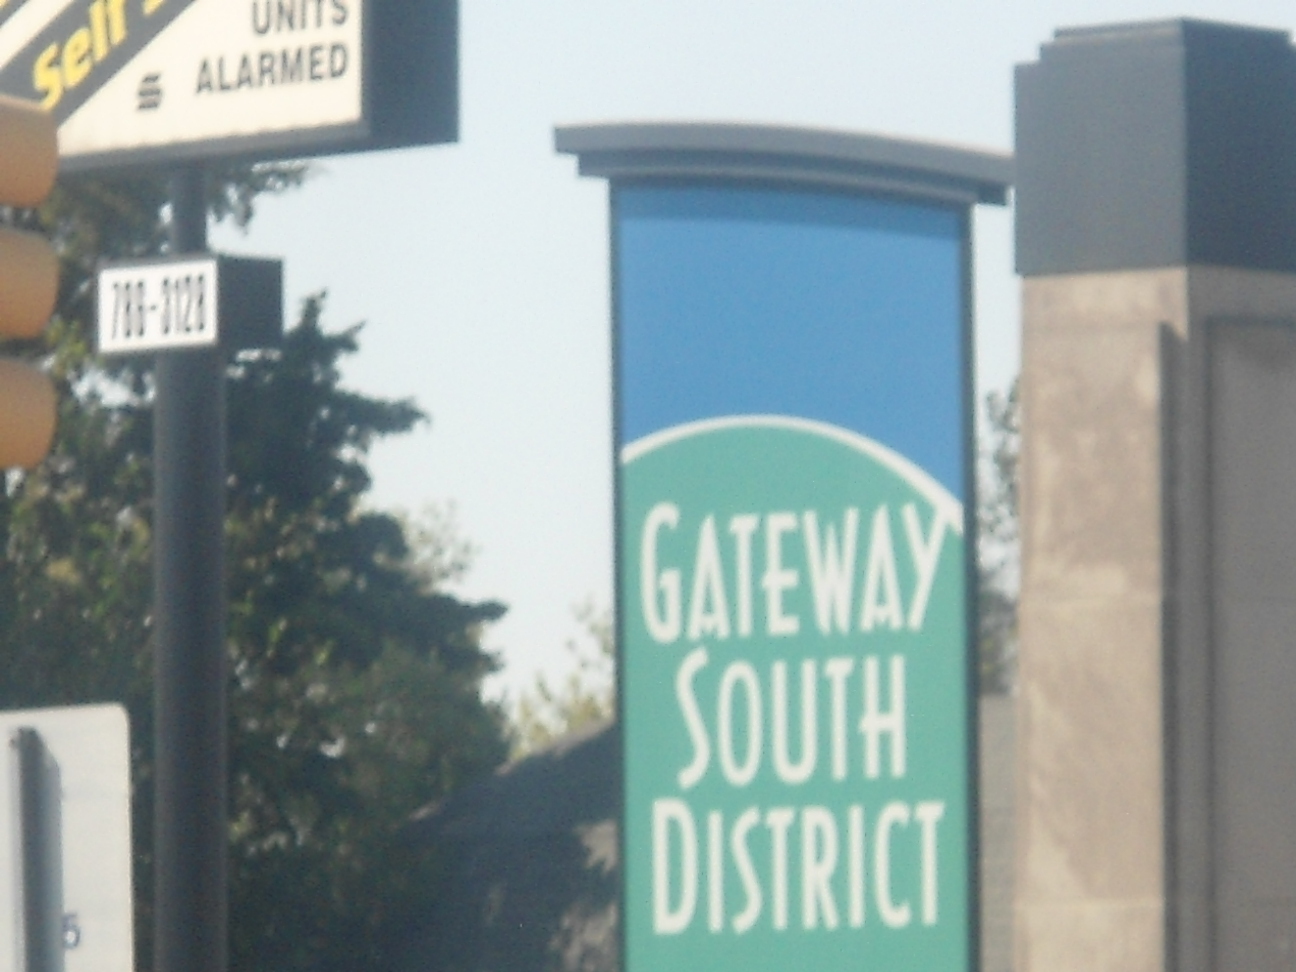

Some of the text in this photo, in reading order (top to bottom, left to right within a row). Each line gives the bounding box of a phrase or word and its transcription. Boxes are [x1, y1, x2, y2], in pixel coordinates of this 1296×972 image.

[252, 0, 350, 35] UNITS
[196, 43, 350, 95] ALARMED
[675, 645, 906, 790] SOUTH
[652, 797, 945, 936] DISTRICT
